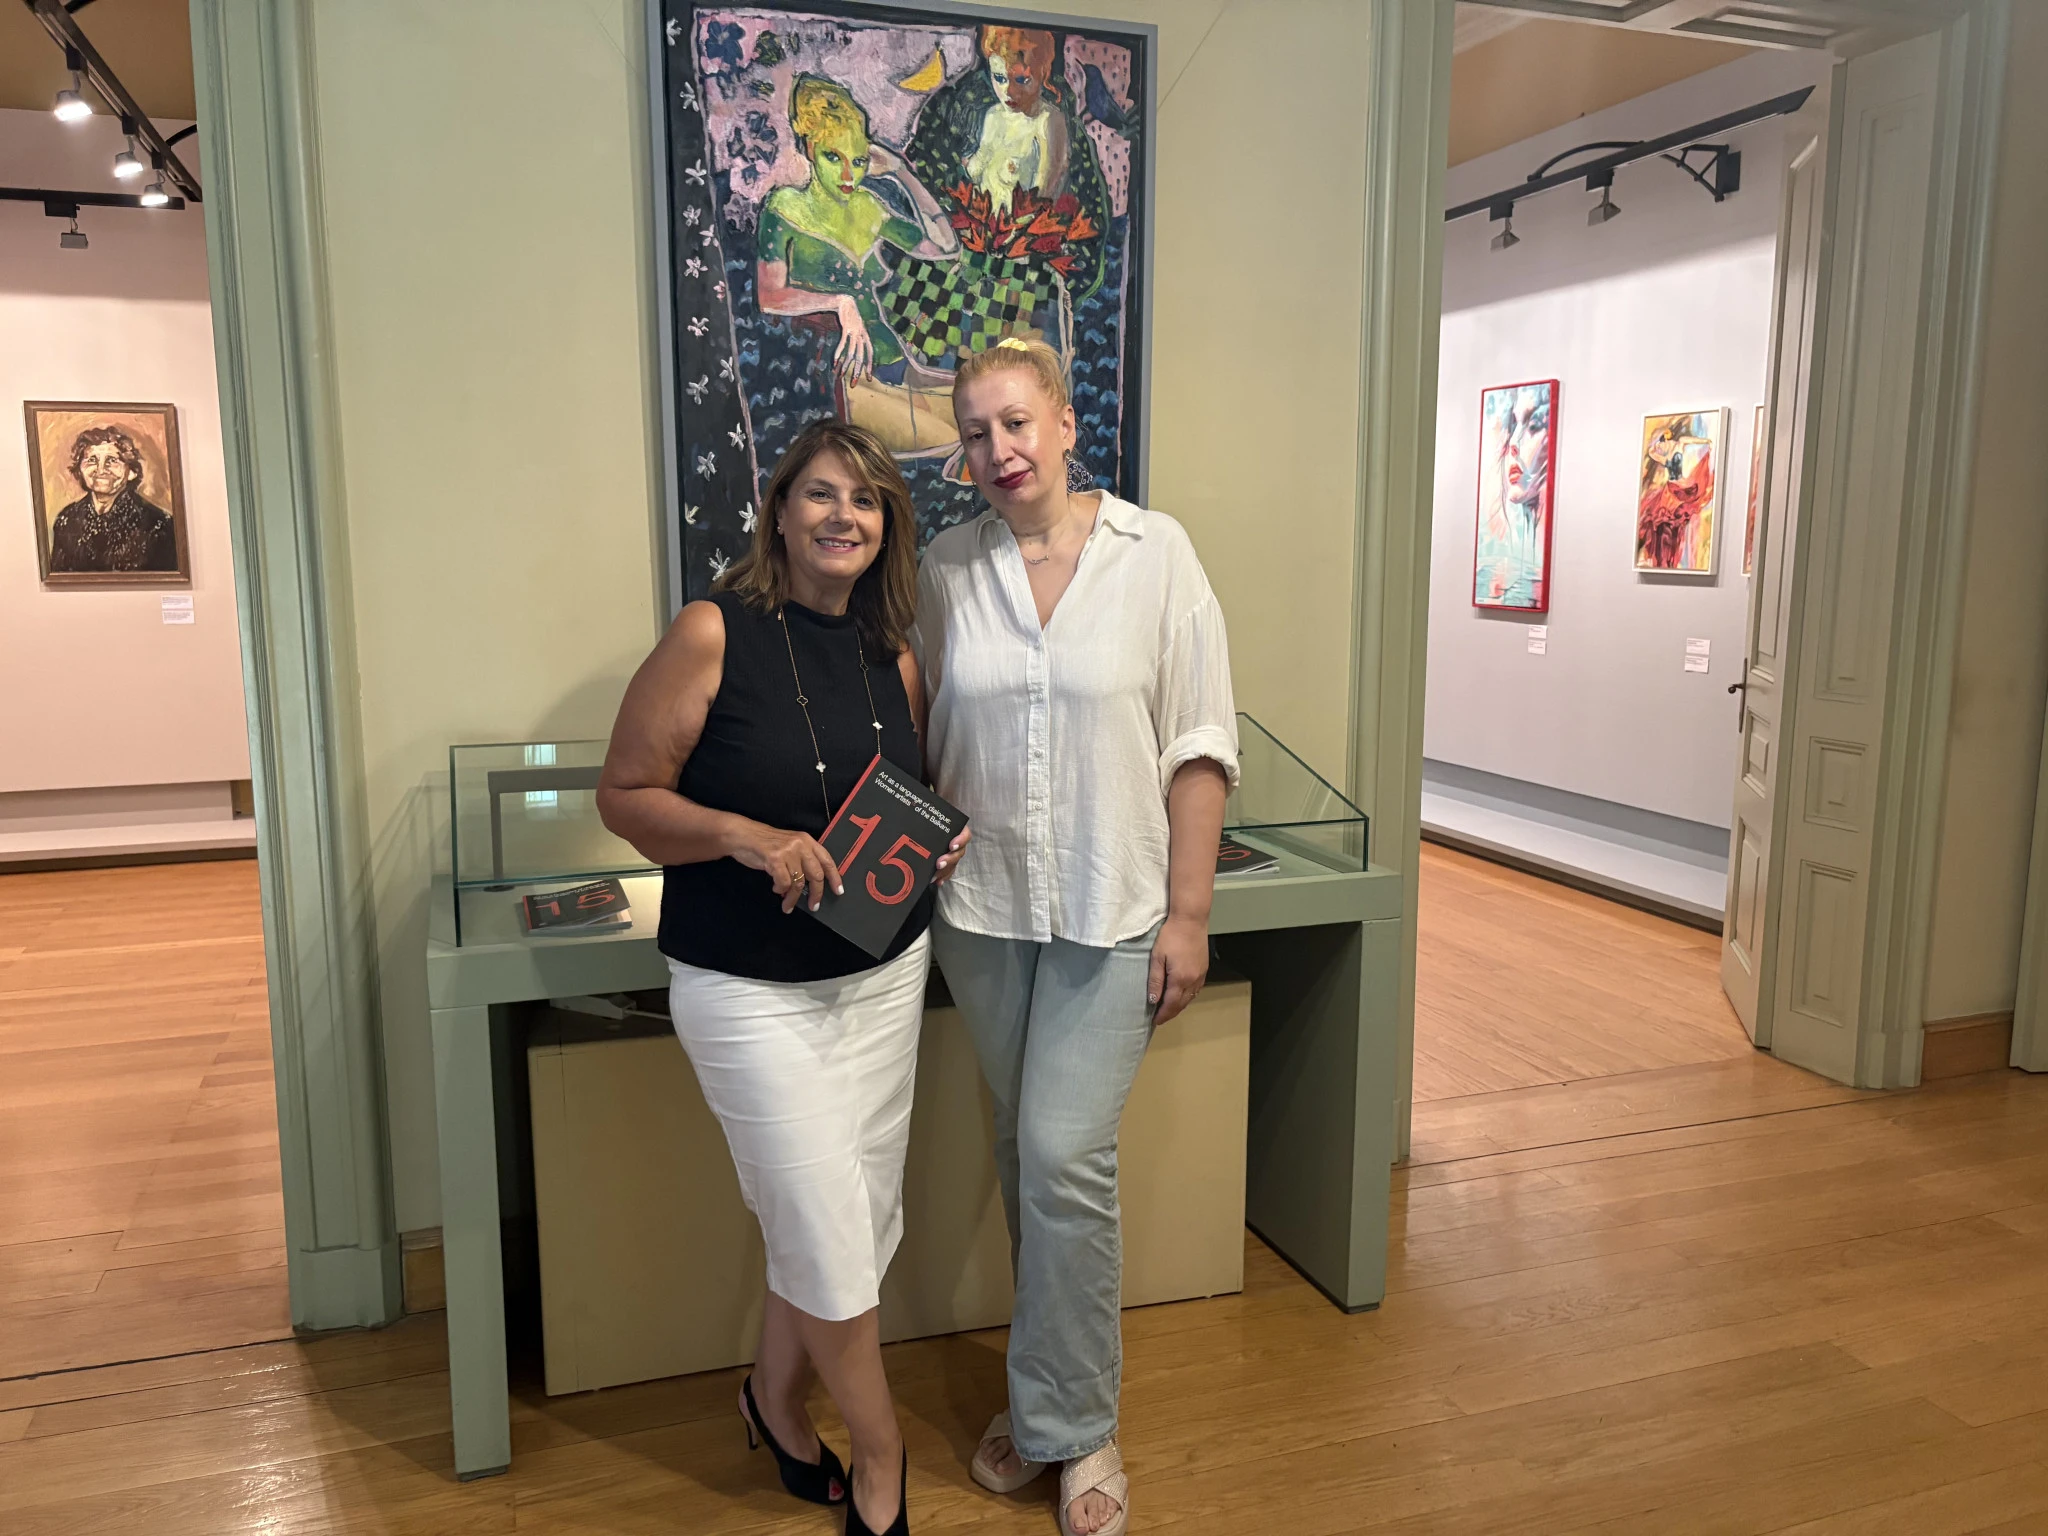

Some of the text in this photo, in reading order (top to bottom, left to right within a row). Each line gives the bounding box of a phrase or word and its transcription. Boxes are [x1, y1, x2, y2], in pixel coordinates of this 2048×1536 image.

[878, 771, 889, 780] Art
[887, 777, 896, 785] as
[899, 784, 923, 804] language
[875, 777, 896, 795] Women
[894, 793, 911, 806] artists
[920, 809, 930, 819] the
[929, 815, 951, 833] Balkans
[837, 813, 931, 905] 15
[1218, 846, 1251, 861] 5
[535, 889, 616, 916] 15
